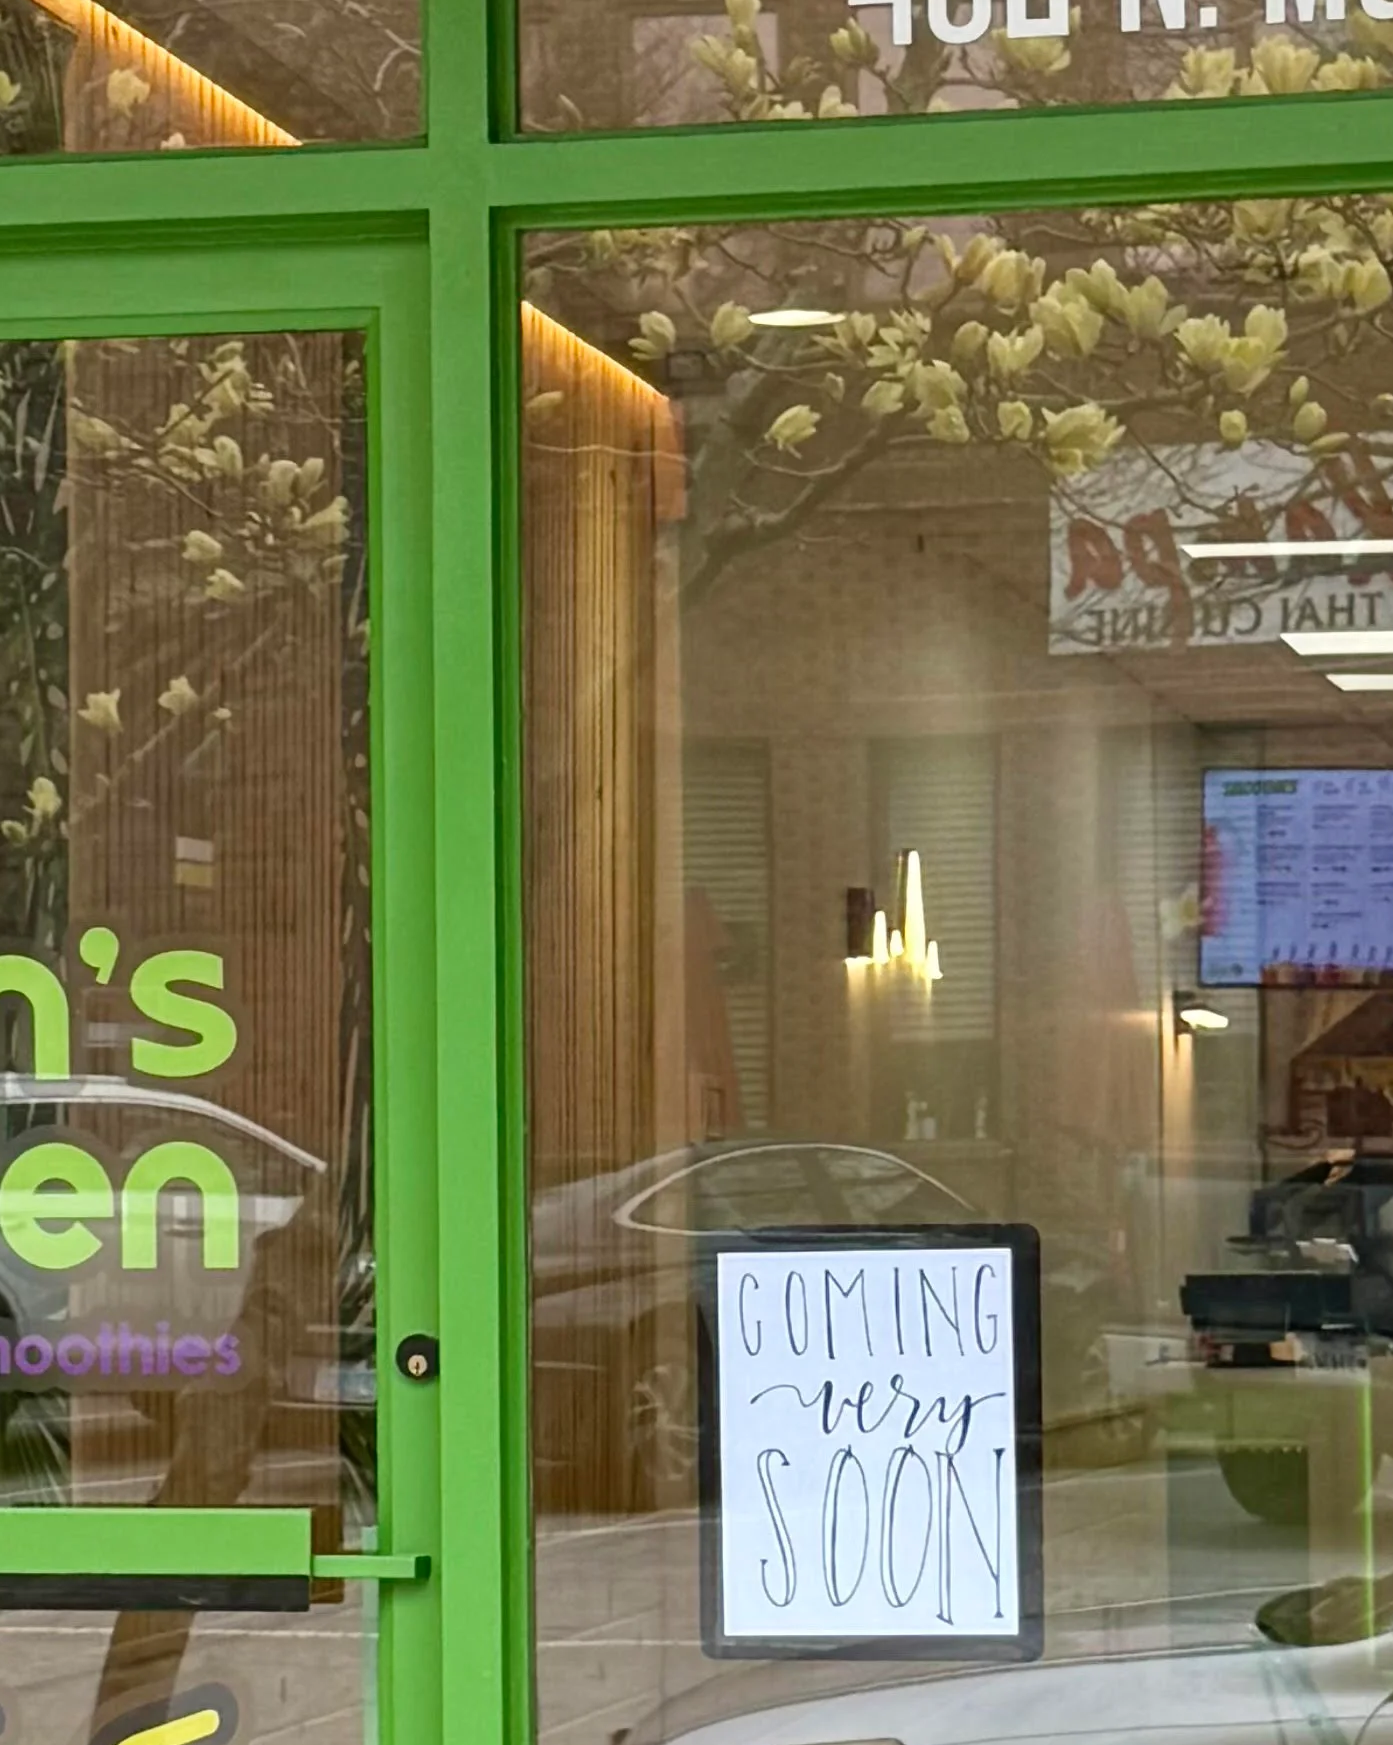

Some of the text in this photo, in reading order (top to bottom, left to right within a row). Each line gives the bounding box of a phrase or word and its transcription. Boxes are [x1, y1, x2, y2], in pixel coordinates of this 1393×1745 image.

[738, 1263, 1000, 1360] COMING
[750, 1373, 1006, 1450] very
[756, 1444, 1006, 1624] SOON
